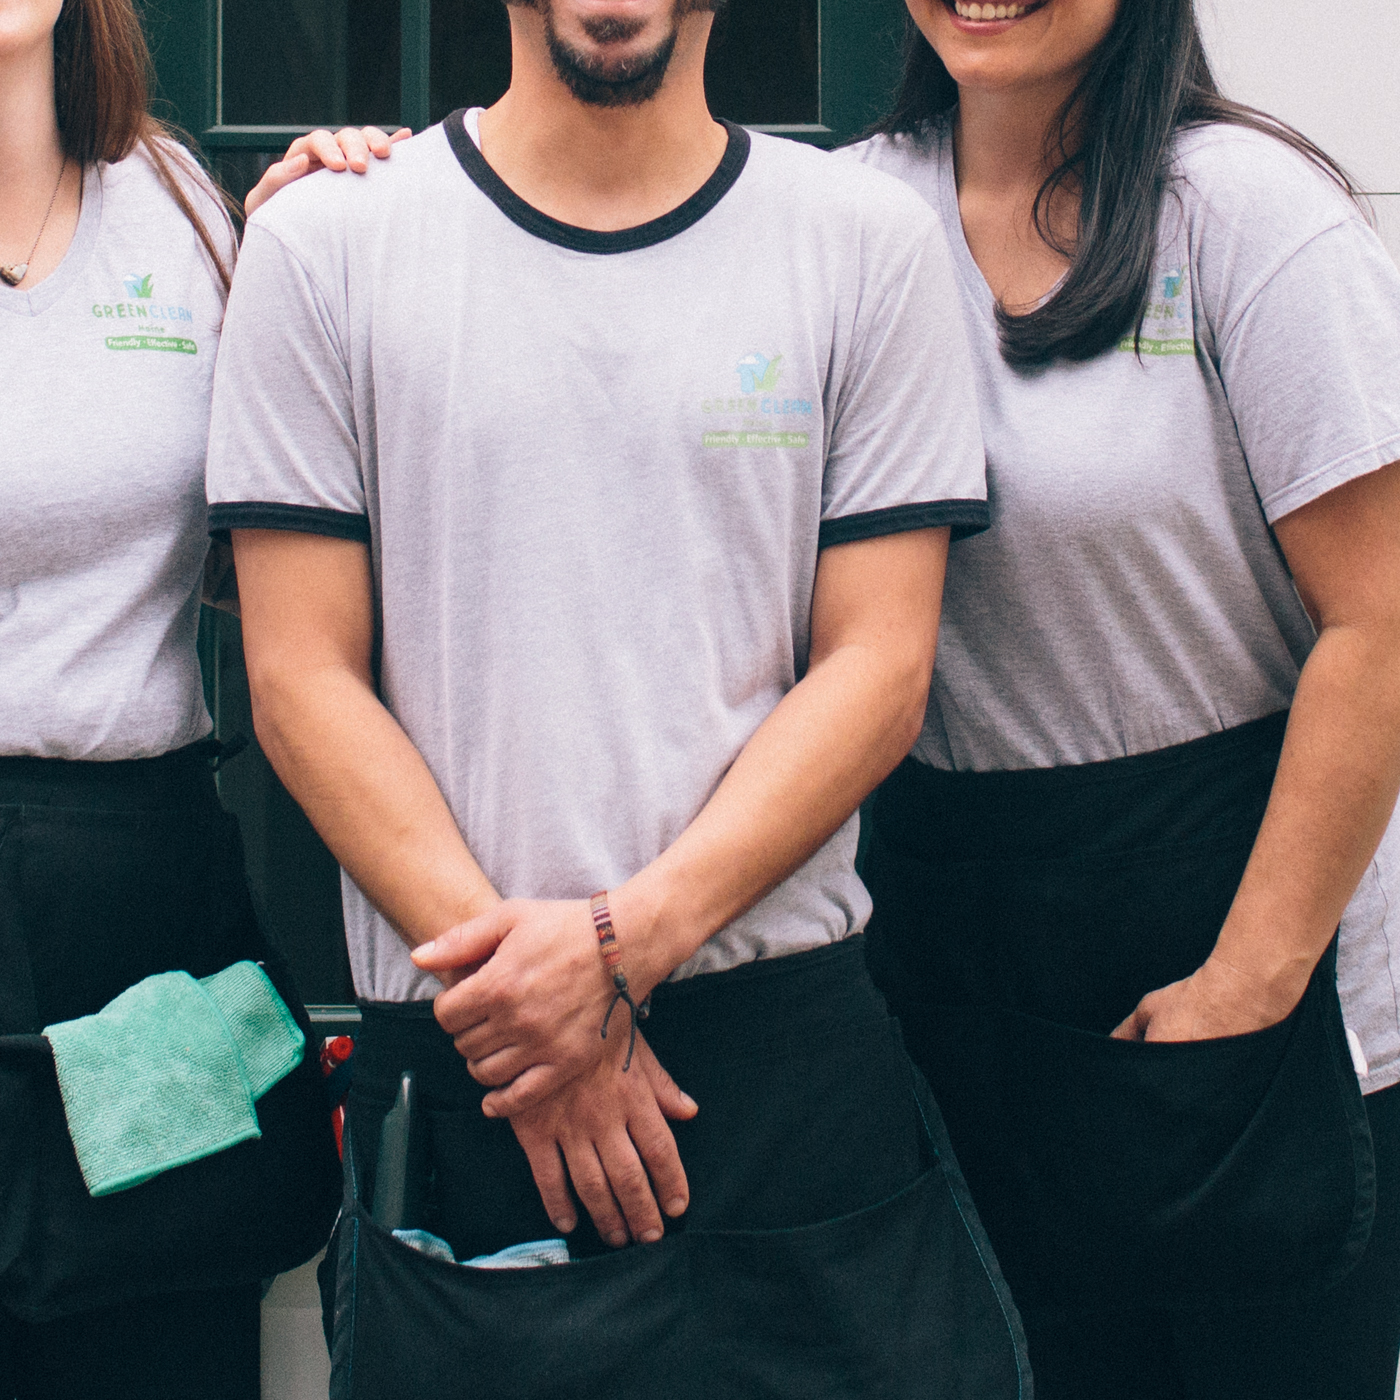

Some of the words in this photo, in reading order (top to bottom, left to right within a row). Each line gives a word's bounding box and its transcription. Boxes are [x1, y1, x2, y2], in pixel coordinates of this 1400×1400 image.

[92, 303, 148, 318] GREEN
[149, 304, 193, 323] CLEAN
[107, 338, 142, 348] Friendly
[701, 398, 758, 414] GREEN
[761, 398, 813, 415] CLEAN
[704, 434, 739, 444] Friendly
[746, 433, 782, 444] Effective
[787, 435, 806, 444] Safe
